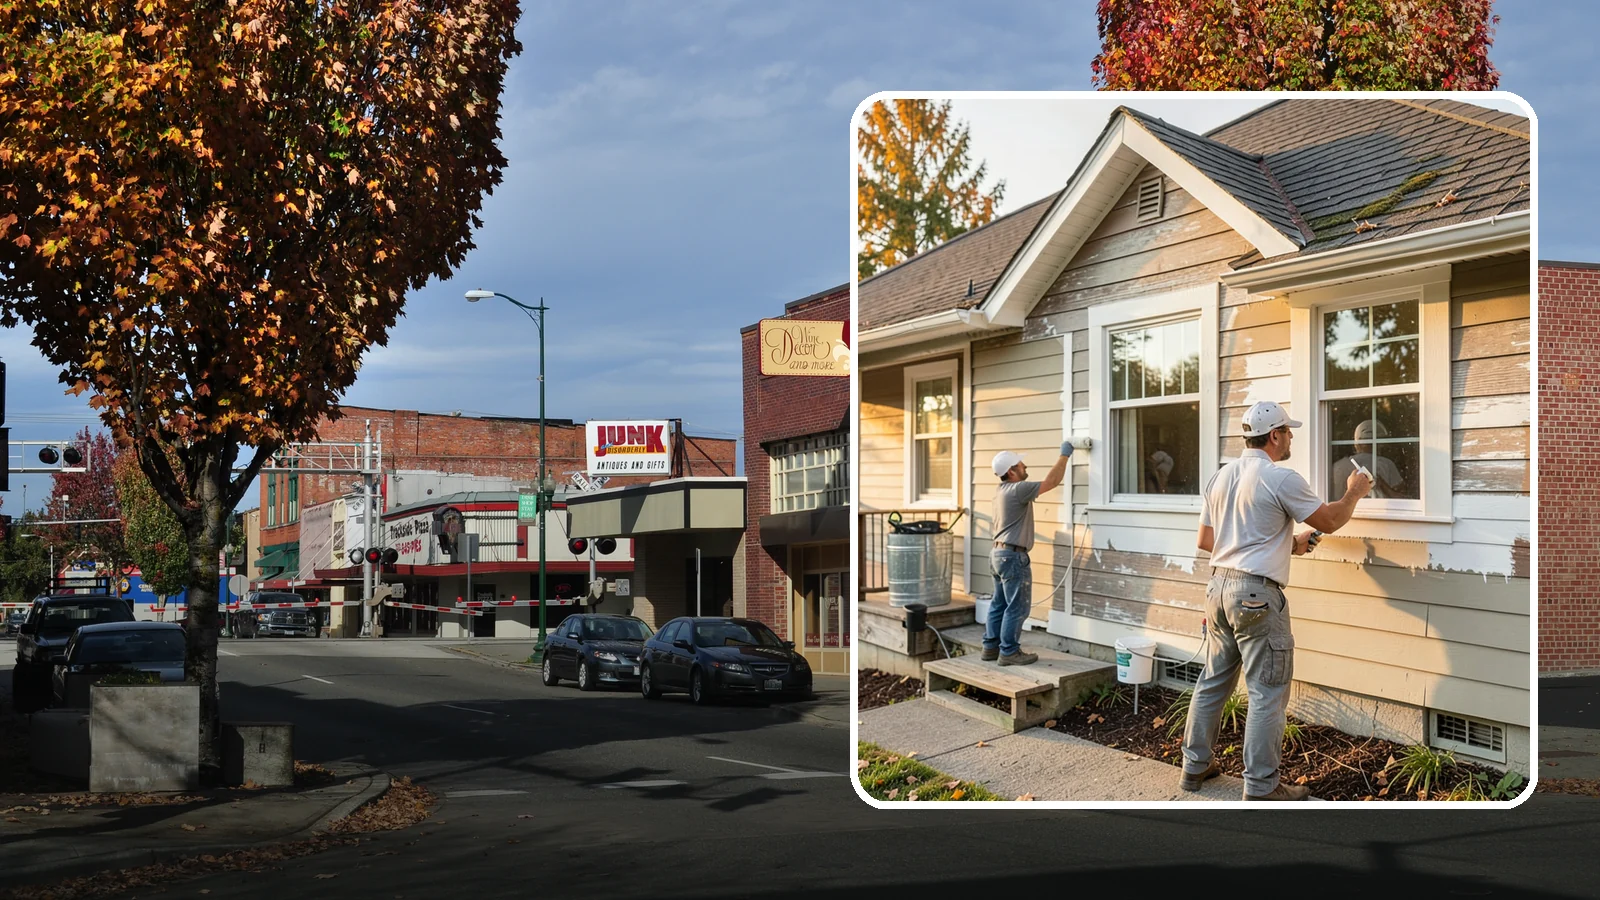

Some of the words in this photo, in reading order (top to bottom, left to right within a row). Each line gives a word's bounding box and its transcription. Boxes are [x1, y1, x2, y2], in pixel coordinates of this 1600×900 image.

[595, 425, 665, 457] JUNK
[607, 446, 646, 454] DISORDERLY
[596, 461, 628, 470] ANTIQUES
[630, 461, 644, 470] AND
[646, 460, 666, 470] GIFTS
[414, 519, 429, 535] Pizza
